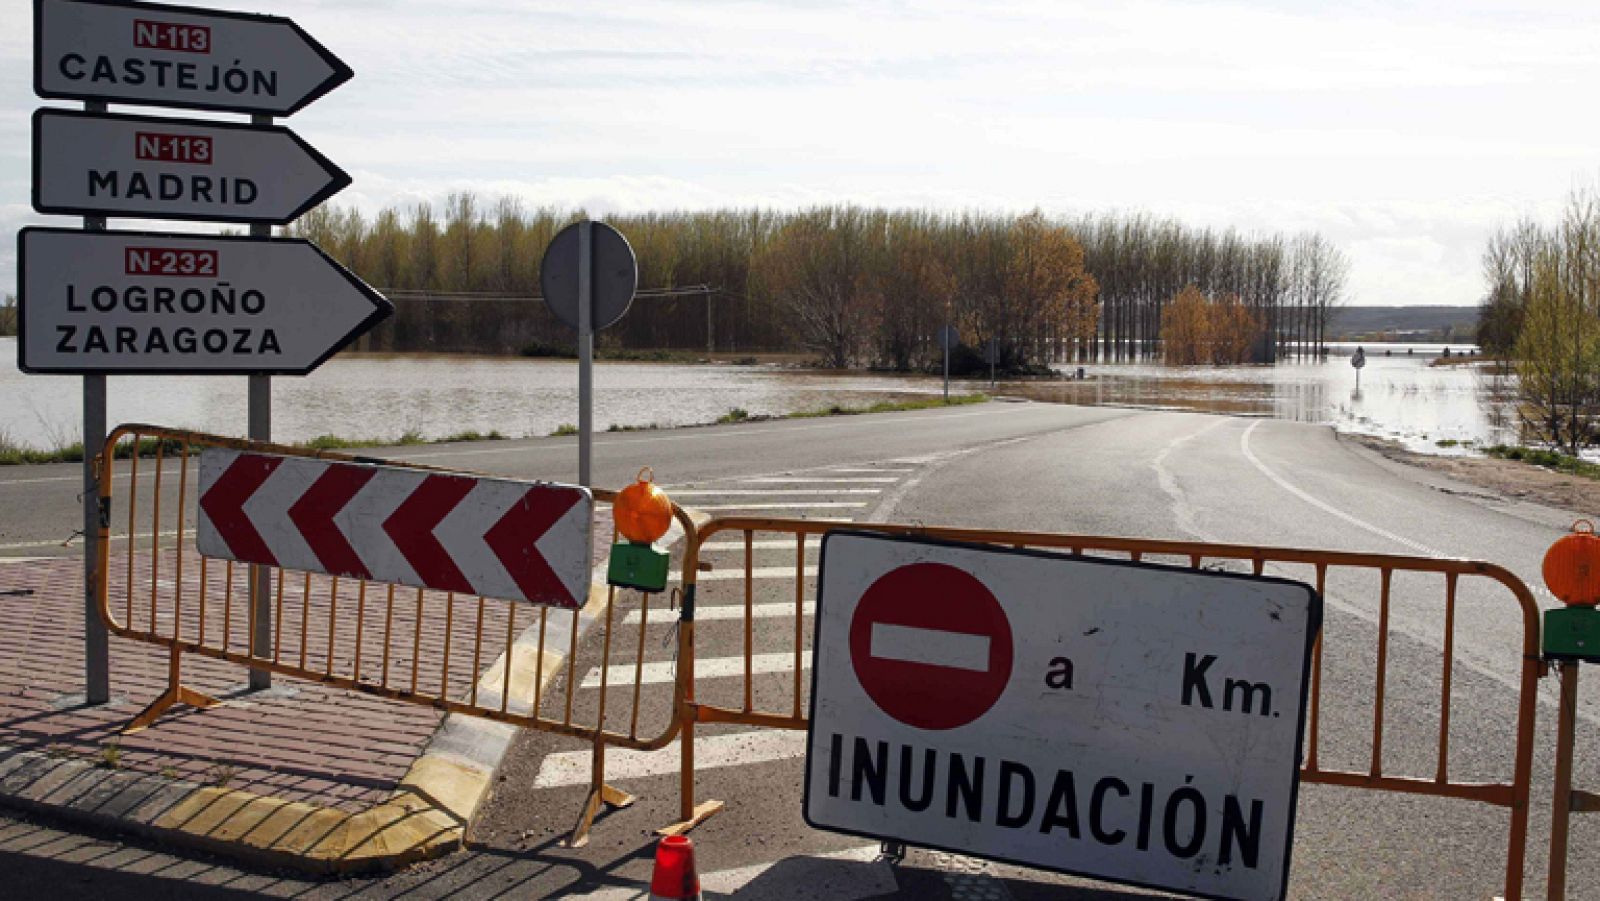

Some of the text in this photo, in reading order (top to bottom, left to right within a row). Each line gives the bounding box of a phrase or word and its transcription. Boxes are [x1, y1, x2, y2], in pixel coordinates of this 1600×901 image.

[136, 23, 208, 51] N-113
[59, 54, 278, 96] CASTEJÓN
[139, 135, 210, 161] N-113
[88, 170, 258, 205] MADRID
[129, 250, 215, 275] N-232
[66, 282, 266, 315] LOGROÑO
[56, 325, 282, 355] ZARAGOZA
[1045, 652, 1280, 718] a Km.
[828, 733, 1264, 869] INUNDACIÓN
